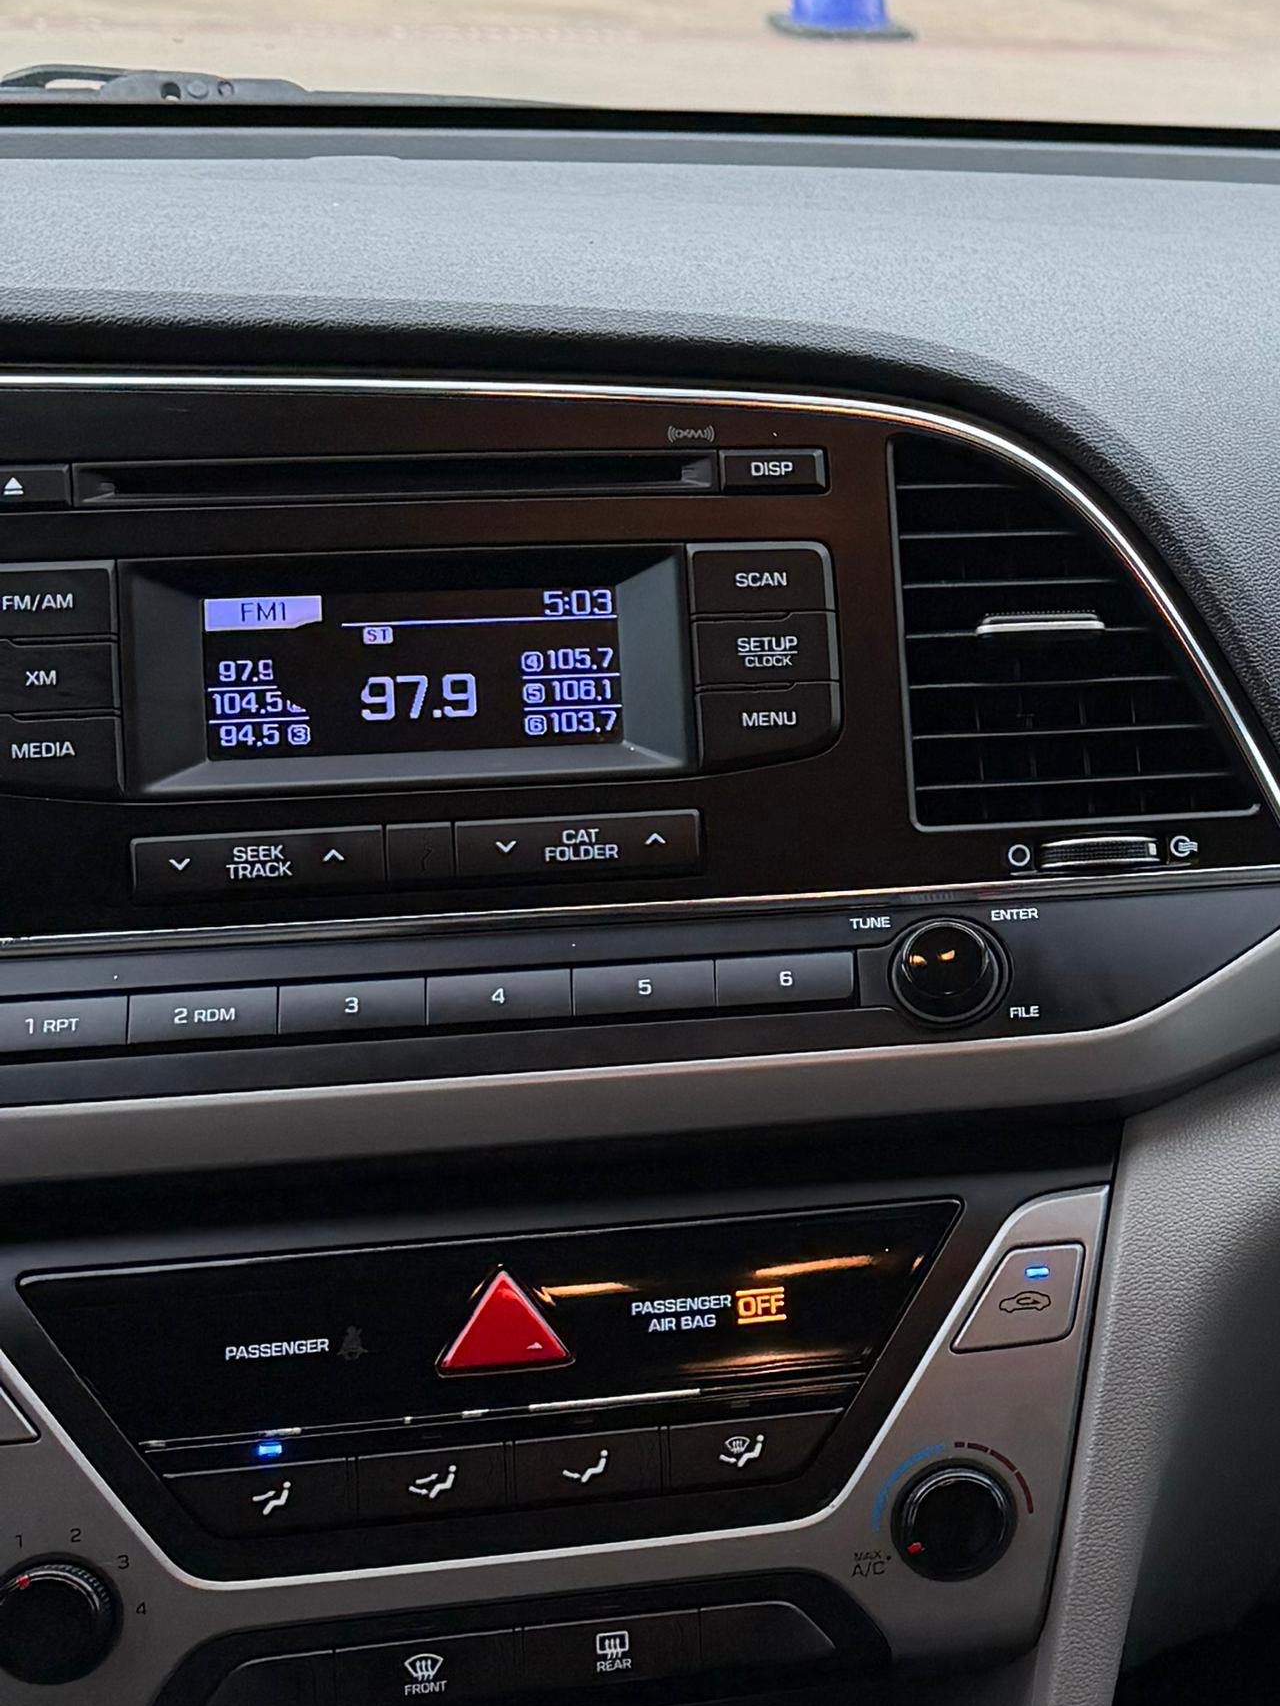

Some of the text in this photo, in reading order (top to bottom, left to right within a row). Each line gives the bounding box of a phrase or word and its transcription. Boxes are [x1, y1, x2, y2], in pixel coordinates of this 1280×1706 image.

[750, 460, 794, 477] DISP
[735, 571, 788, 587] SCAN
[2, 593, 74, 611] FM/AM
[543, 589, 613, 616] 5:03
[241, 602, 287, 622] FM1
[366, 628, 390, 642] ST
[737, 635, 799, 652] SETUP
[547, 647, 614, 670] 105.7
[744, 654, 793, 668] CLOCK
[25, 670, 58, 686] XM
[218, 659, 274, 682] 97.9
[360, 673, 477, 721] 97.9
[552, 679, 612, 701] 106.1
[212, 691, 283, 715] 104.5
[550, 710, 617, 733] 103.7
[742, 711, 797, 727] MENU
[219, 724, 280, 747] 94.5
[11, 741, 76, 759] MEDIA
[562, 828, 600, 845] CAT
[233, 845, 284, 862] SEEK
[544, 843, 619, 862] FOLDER
[226, 861, 293, 880] TRACK
[850, 916, 891, 930] TUNE
[990, 907, 1039, 922] ENTER
[638, 979, 653, 995] 5
[779, 970, 793, 987] 6
[344, 996, 359, 1013] 3
[491, 987, 506, 1005] 4
[174, 1007, 236, 1024] 2 RDM
[1009, 1005, 1040, 1019] FILE
[25, 1018, 80, 1034] 1 RPT
[631, 1294, 732, 1316] PASSENGER
[737, 1295, 785, 1317] OFF
[648, 1312, 717, 1333] AIR BAG
[224, 1338, 330, 1361] PASSENGER
[15, 1534, 23, 1549] 1
[70, 1527, 82, 1543] 2
[117, 1554, 130, 1569] 3
[851, 1560, 886, 1577] A/C
[136, 1602, 147, 1615] 4
[596, 1658, 632, 1673] REAR
[404, 1679, 447, 1696] FRONT
